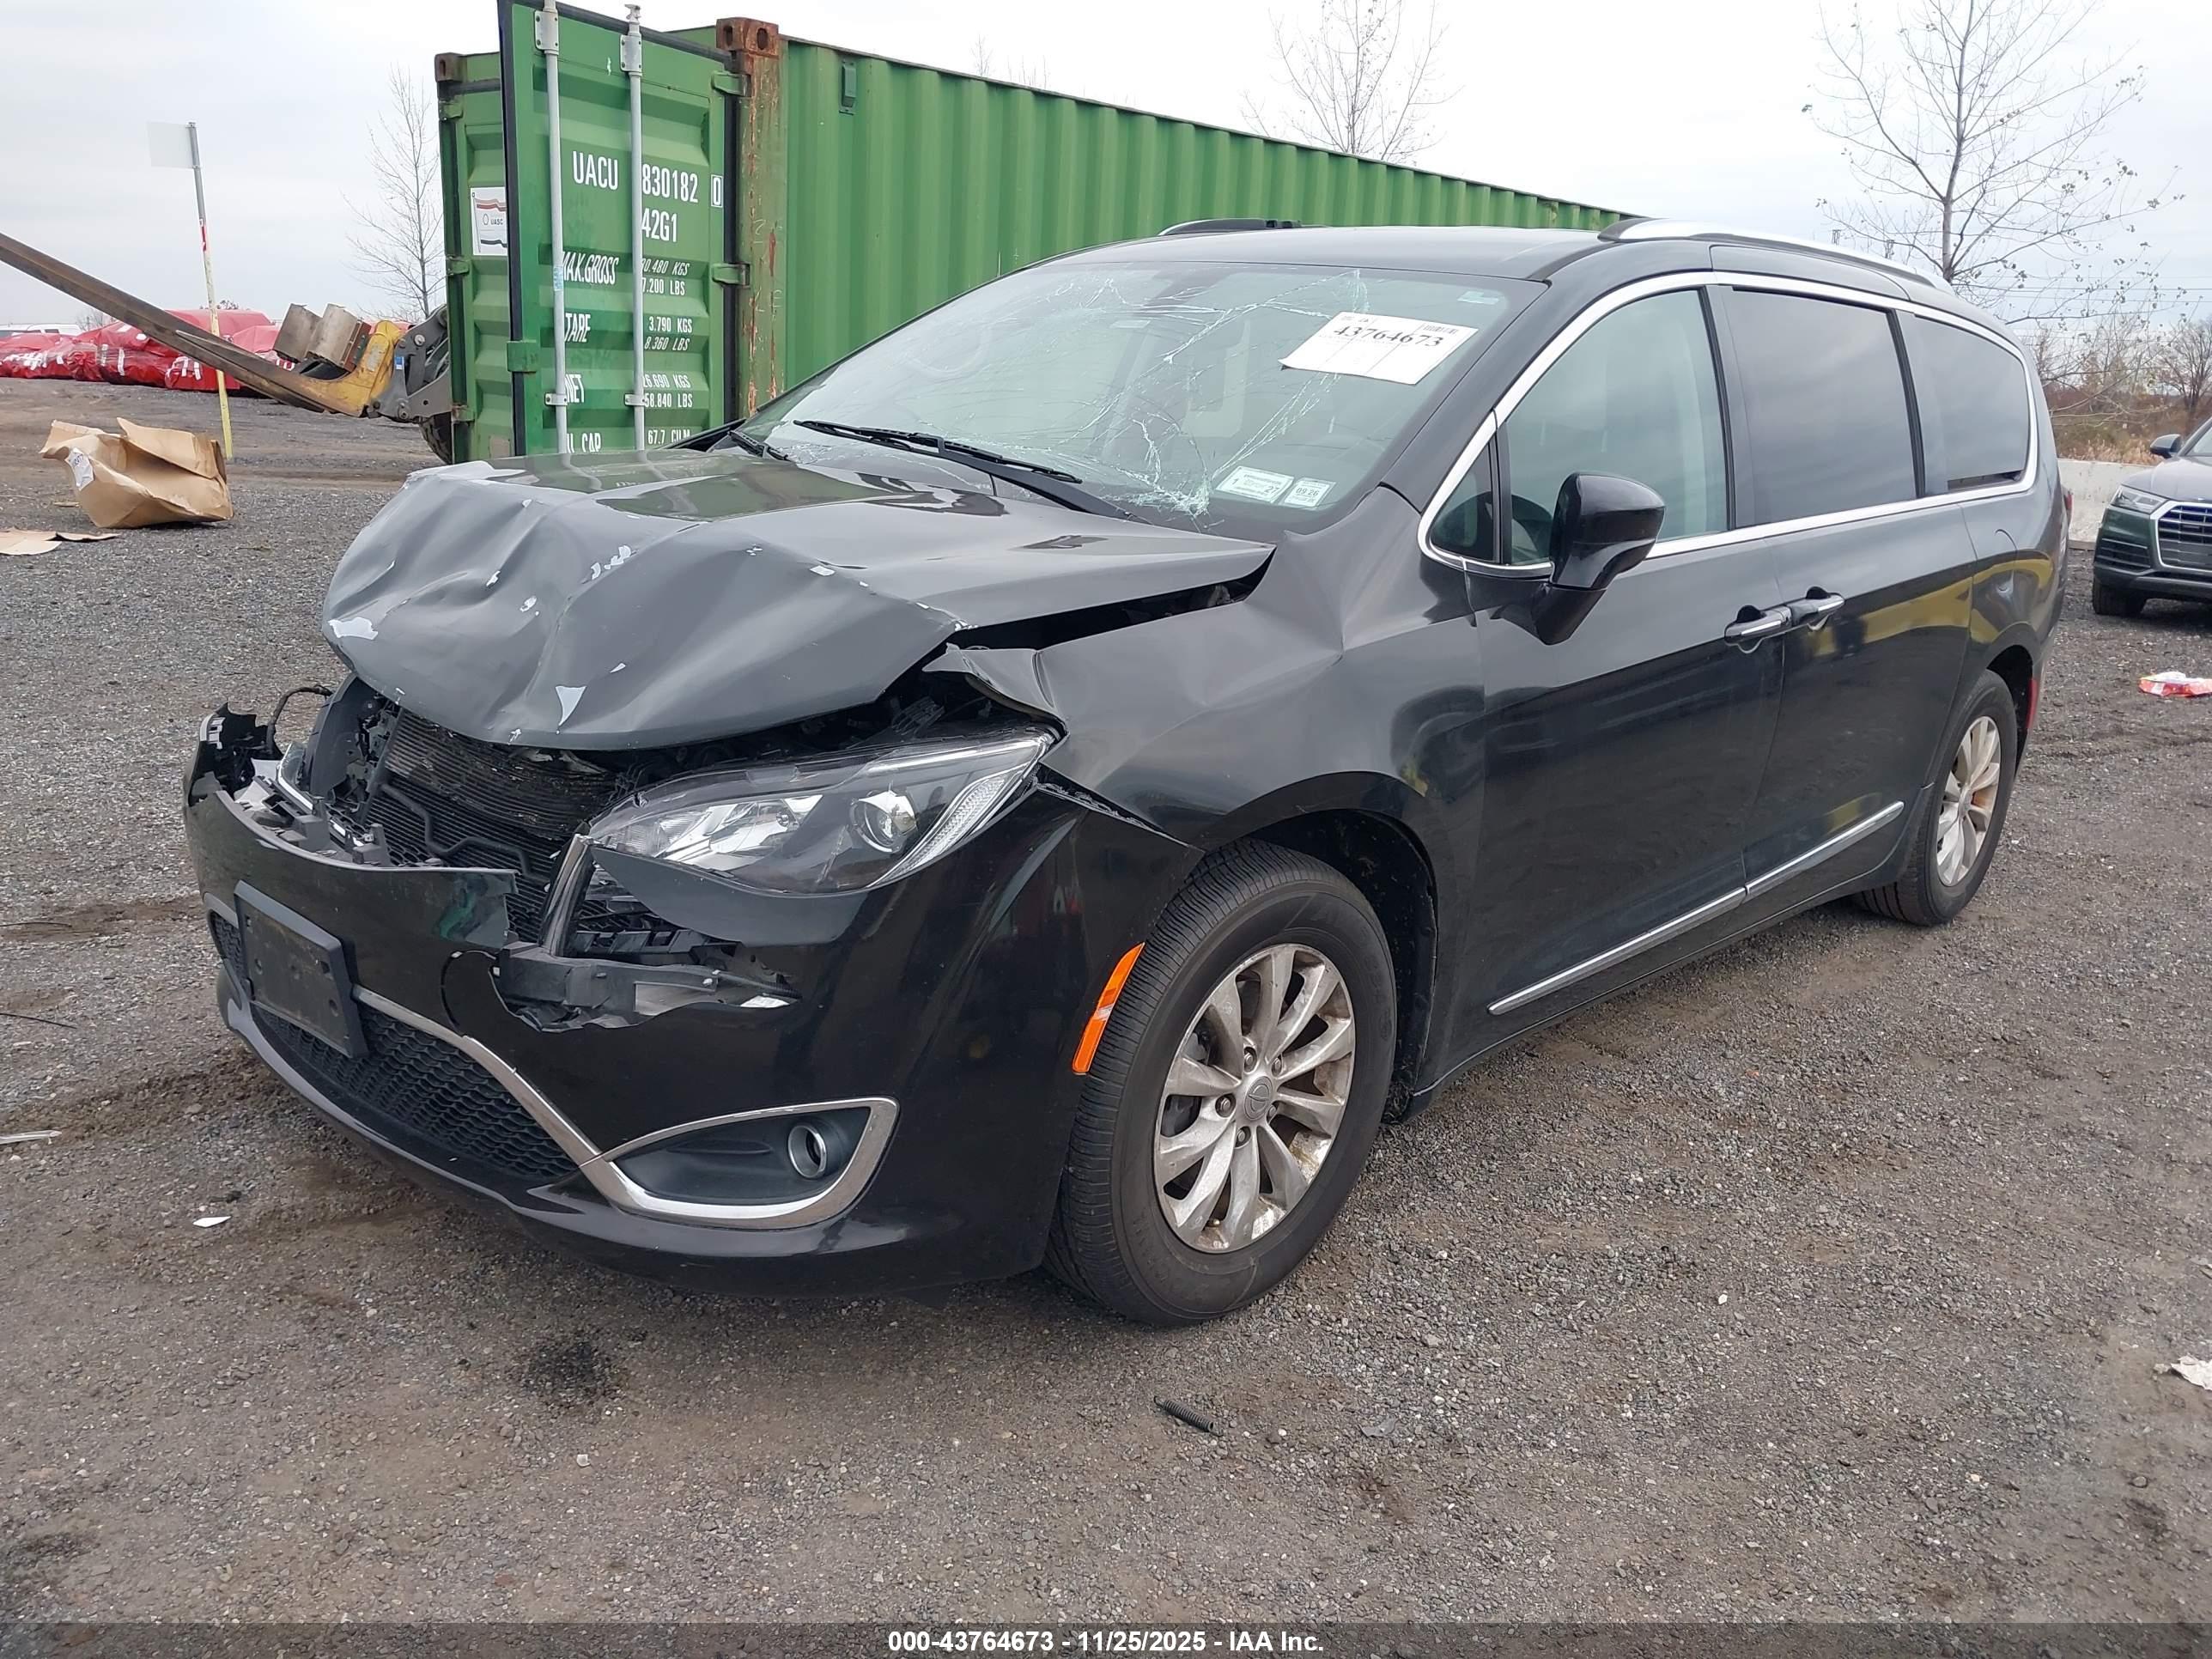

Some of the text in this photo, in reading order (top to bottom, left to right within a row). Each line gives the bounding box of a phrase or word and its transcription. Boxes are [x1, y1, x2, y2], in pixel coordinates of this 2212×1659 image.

[573, 150, 619, 191] UACU
[642, 164, 699, 204] 830182
[641, 207, 678, 243] 42G1
[672, 263, 690, 276] KGS
[670, 280, 685, 296] LBS
[564, 313, 693, 343] TARE 3.790 KGS
[1334, 325, 1444, 347] 43764673
[644, 336, 690, 351] 8.360 LBS
[565, 374, 585, 404] NET
[673, 374, 691, 388] KGS
[645, 392, 693, 408] 58.840 LBS
[647, 429, 665, 445] 67.7
